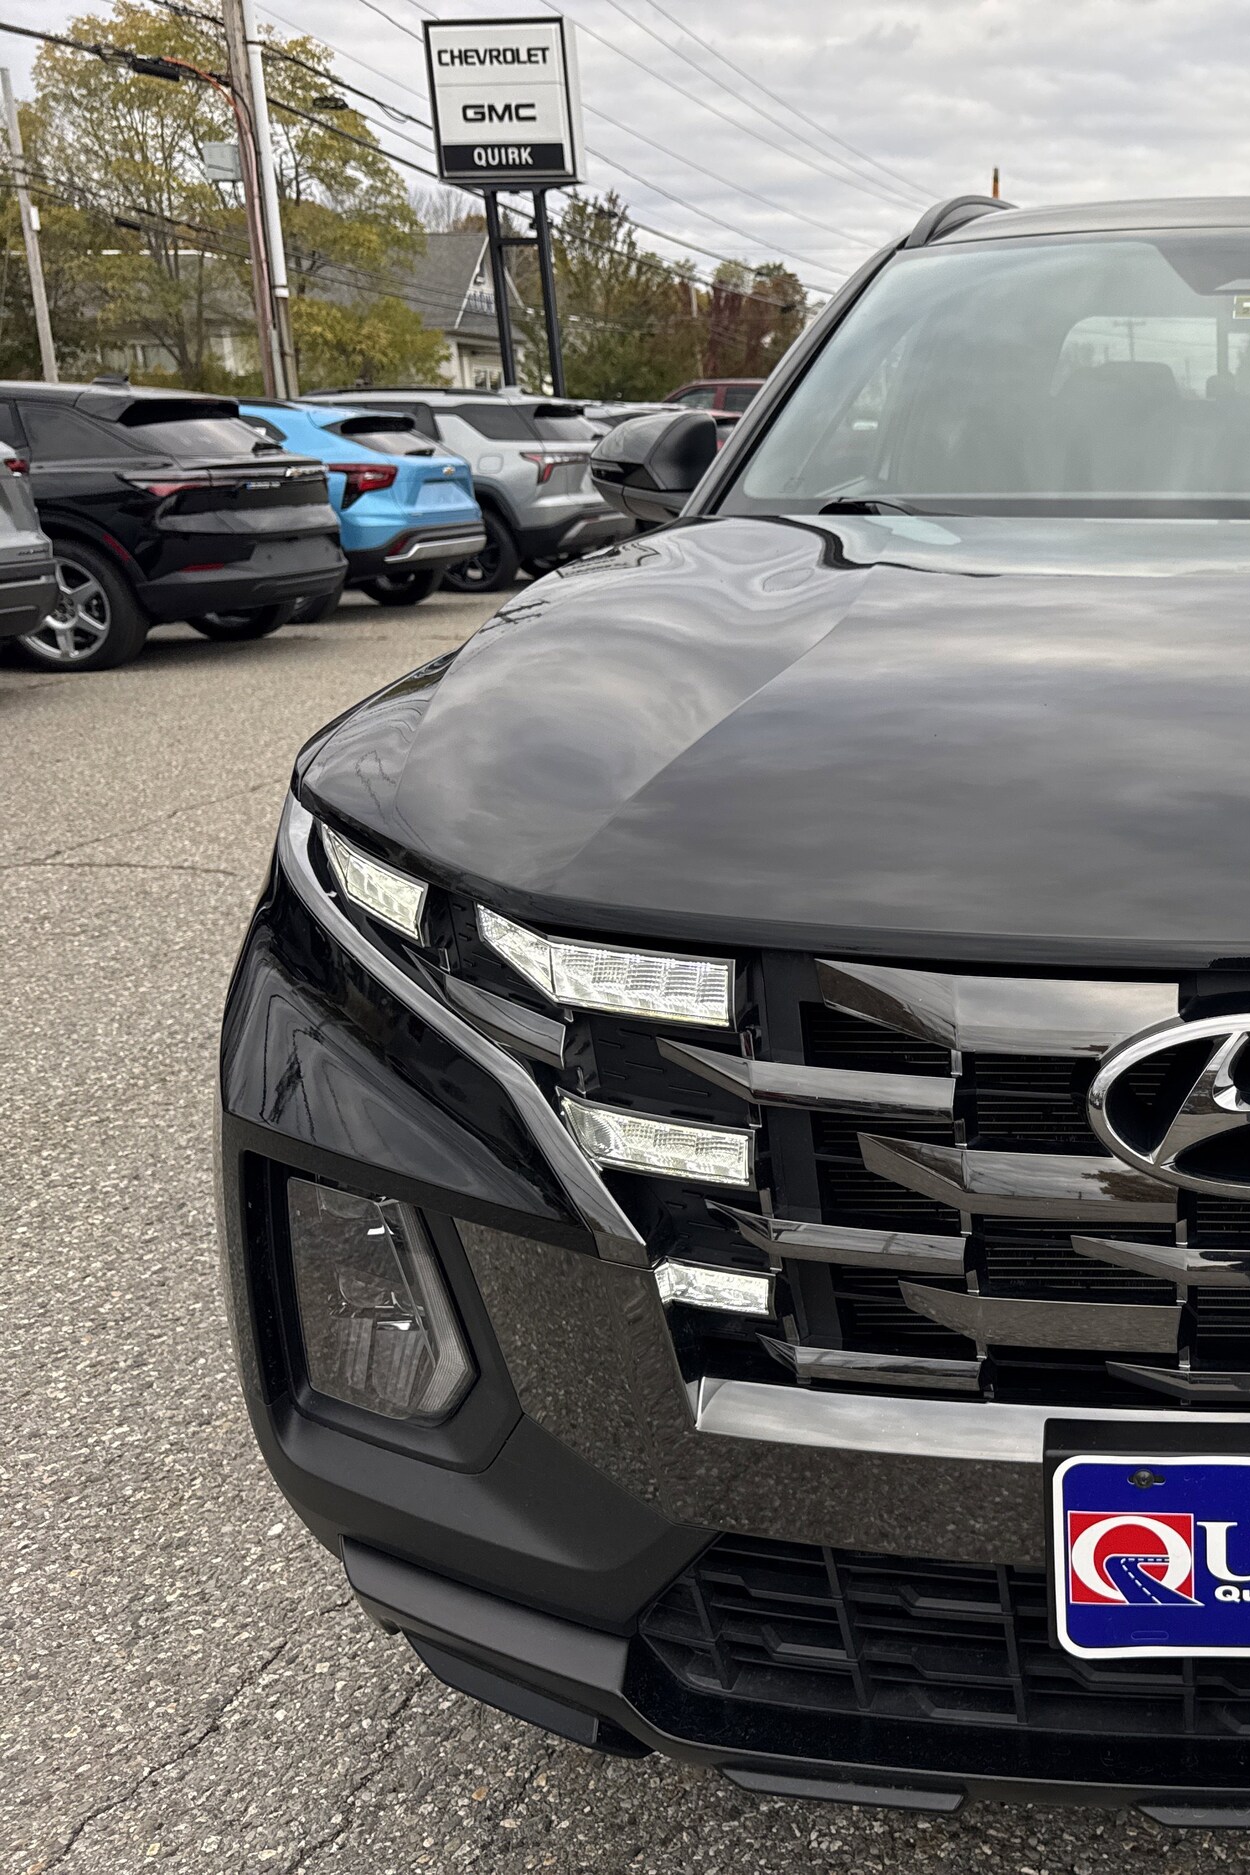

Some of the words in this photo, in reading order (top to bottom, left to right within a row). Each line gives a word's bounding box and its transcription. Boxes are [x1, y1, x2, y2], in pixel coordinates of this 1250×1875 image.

[437, 47, 549, 66] CHEVROLET
[462, 103, 537, 122] GMC
[473, 147, 533, 167] QUIRK
